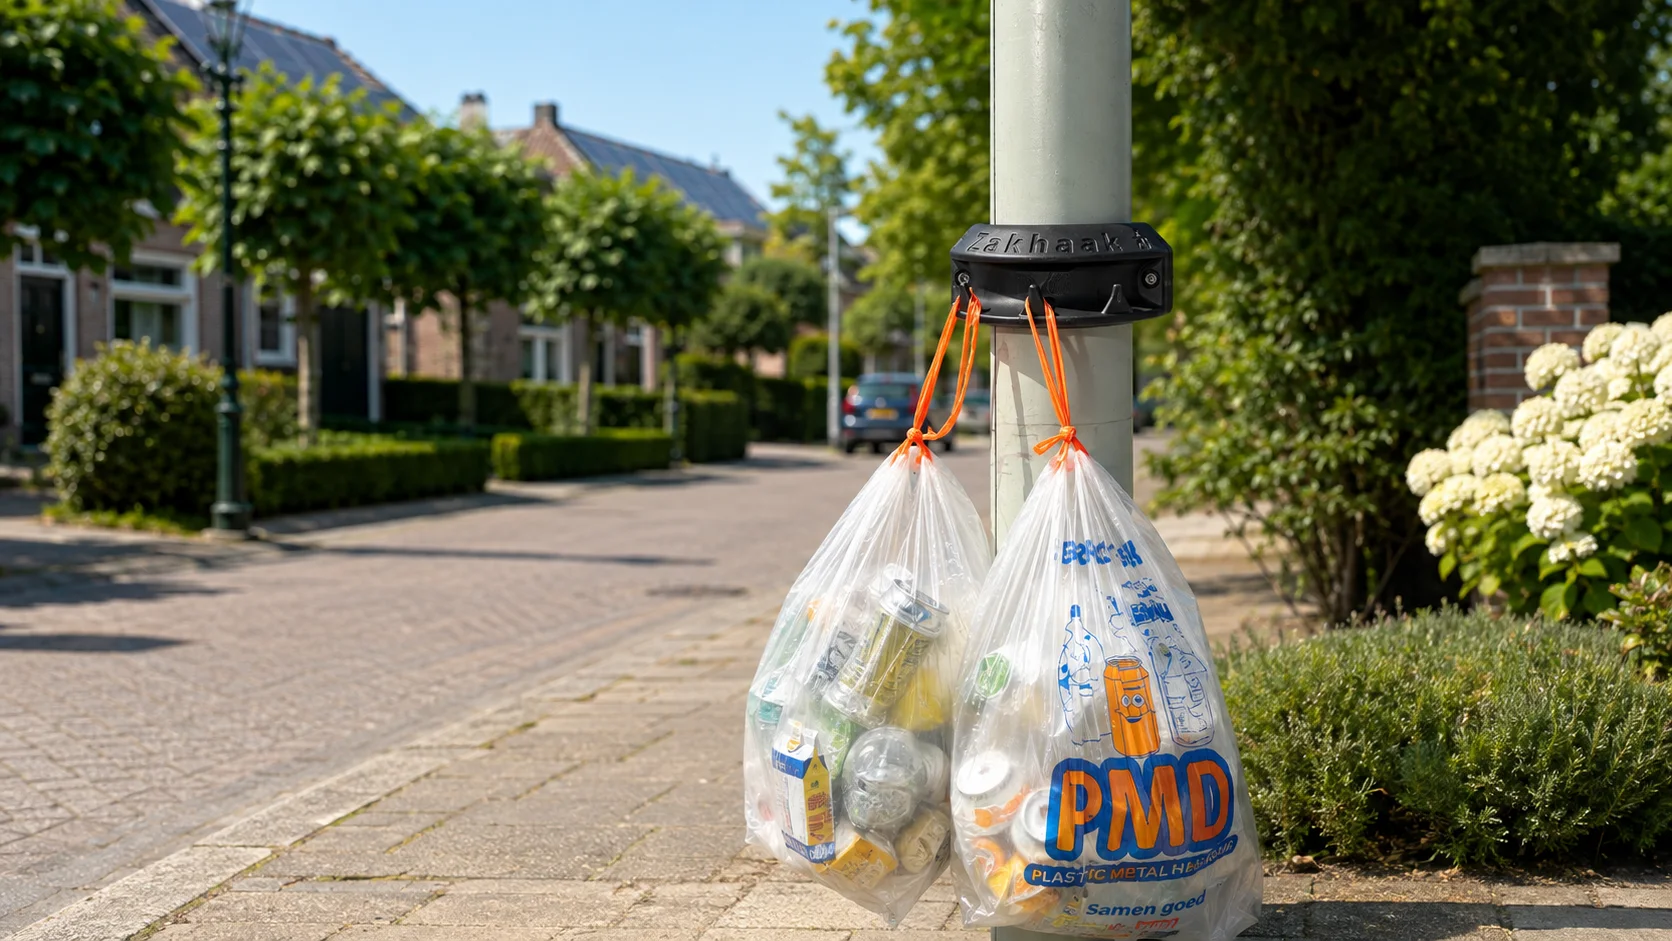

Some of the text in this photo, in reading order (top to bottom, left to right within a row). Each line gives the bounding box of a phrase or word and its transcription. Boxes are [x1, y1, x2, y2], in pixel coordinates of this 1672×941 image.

[965, 231, 1124, 254] Zakhaak
[1055, 758, 1231, 852] PMD
[1031, 868, 1106, 884] PLASTIC
[1086, 903, 1156, 917] Samen
[1160, 889, 1206, 917] goed
